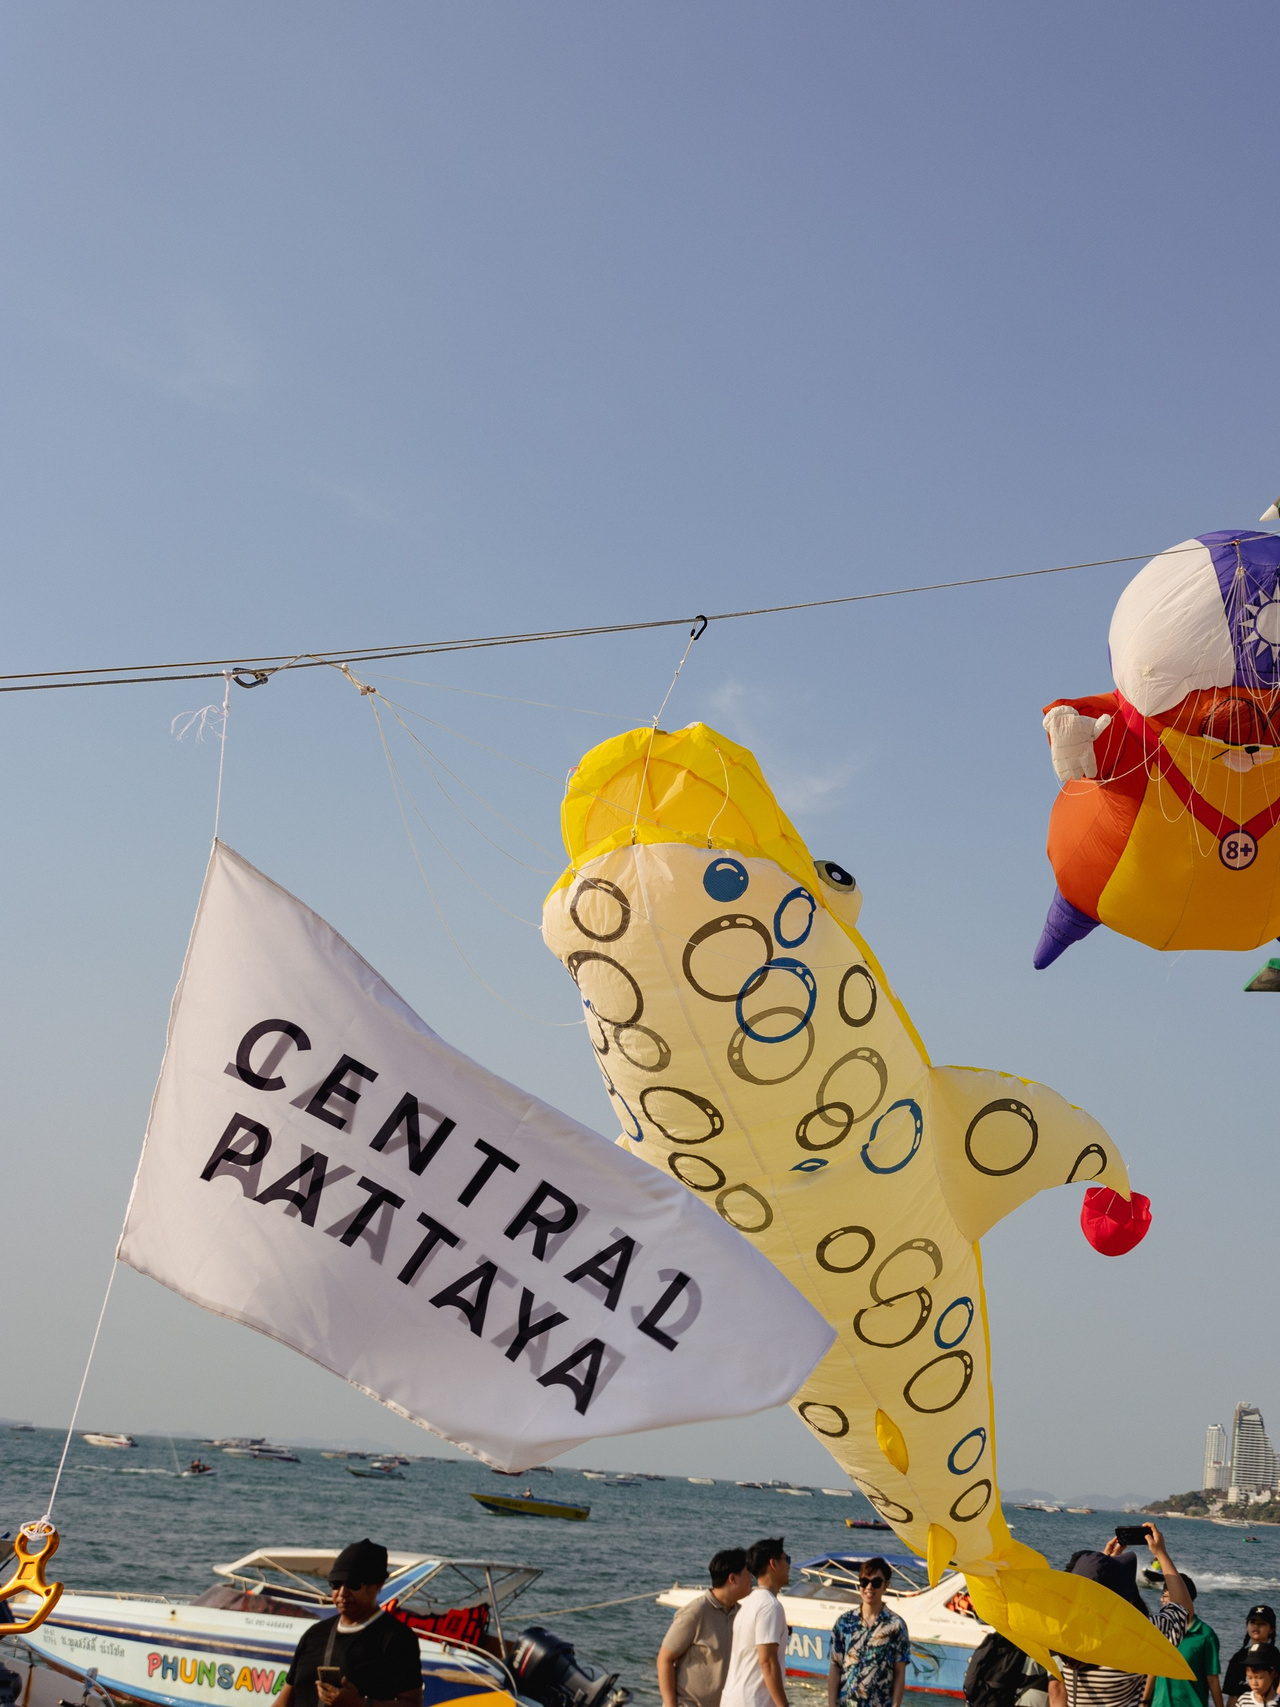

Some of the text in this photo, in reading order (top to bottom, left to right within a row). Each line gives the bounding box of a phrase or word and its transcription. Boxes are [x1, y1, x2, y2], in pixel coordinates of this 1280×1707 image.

[1226, 841, 1252, 859] 8+
[199, 1112, 609, 1417] PATTAYA
[236, 1018, 692, 1352] CENTRAL
[785, 1632, 823, 1660] AN
